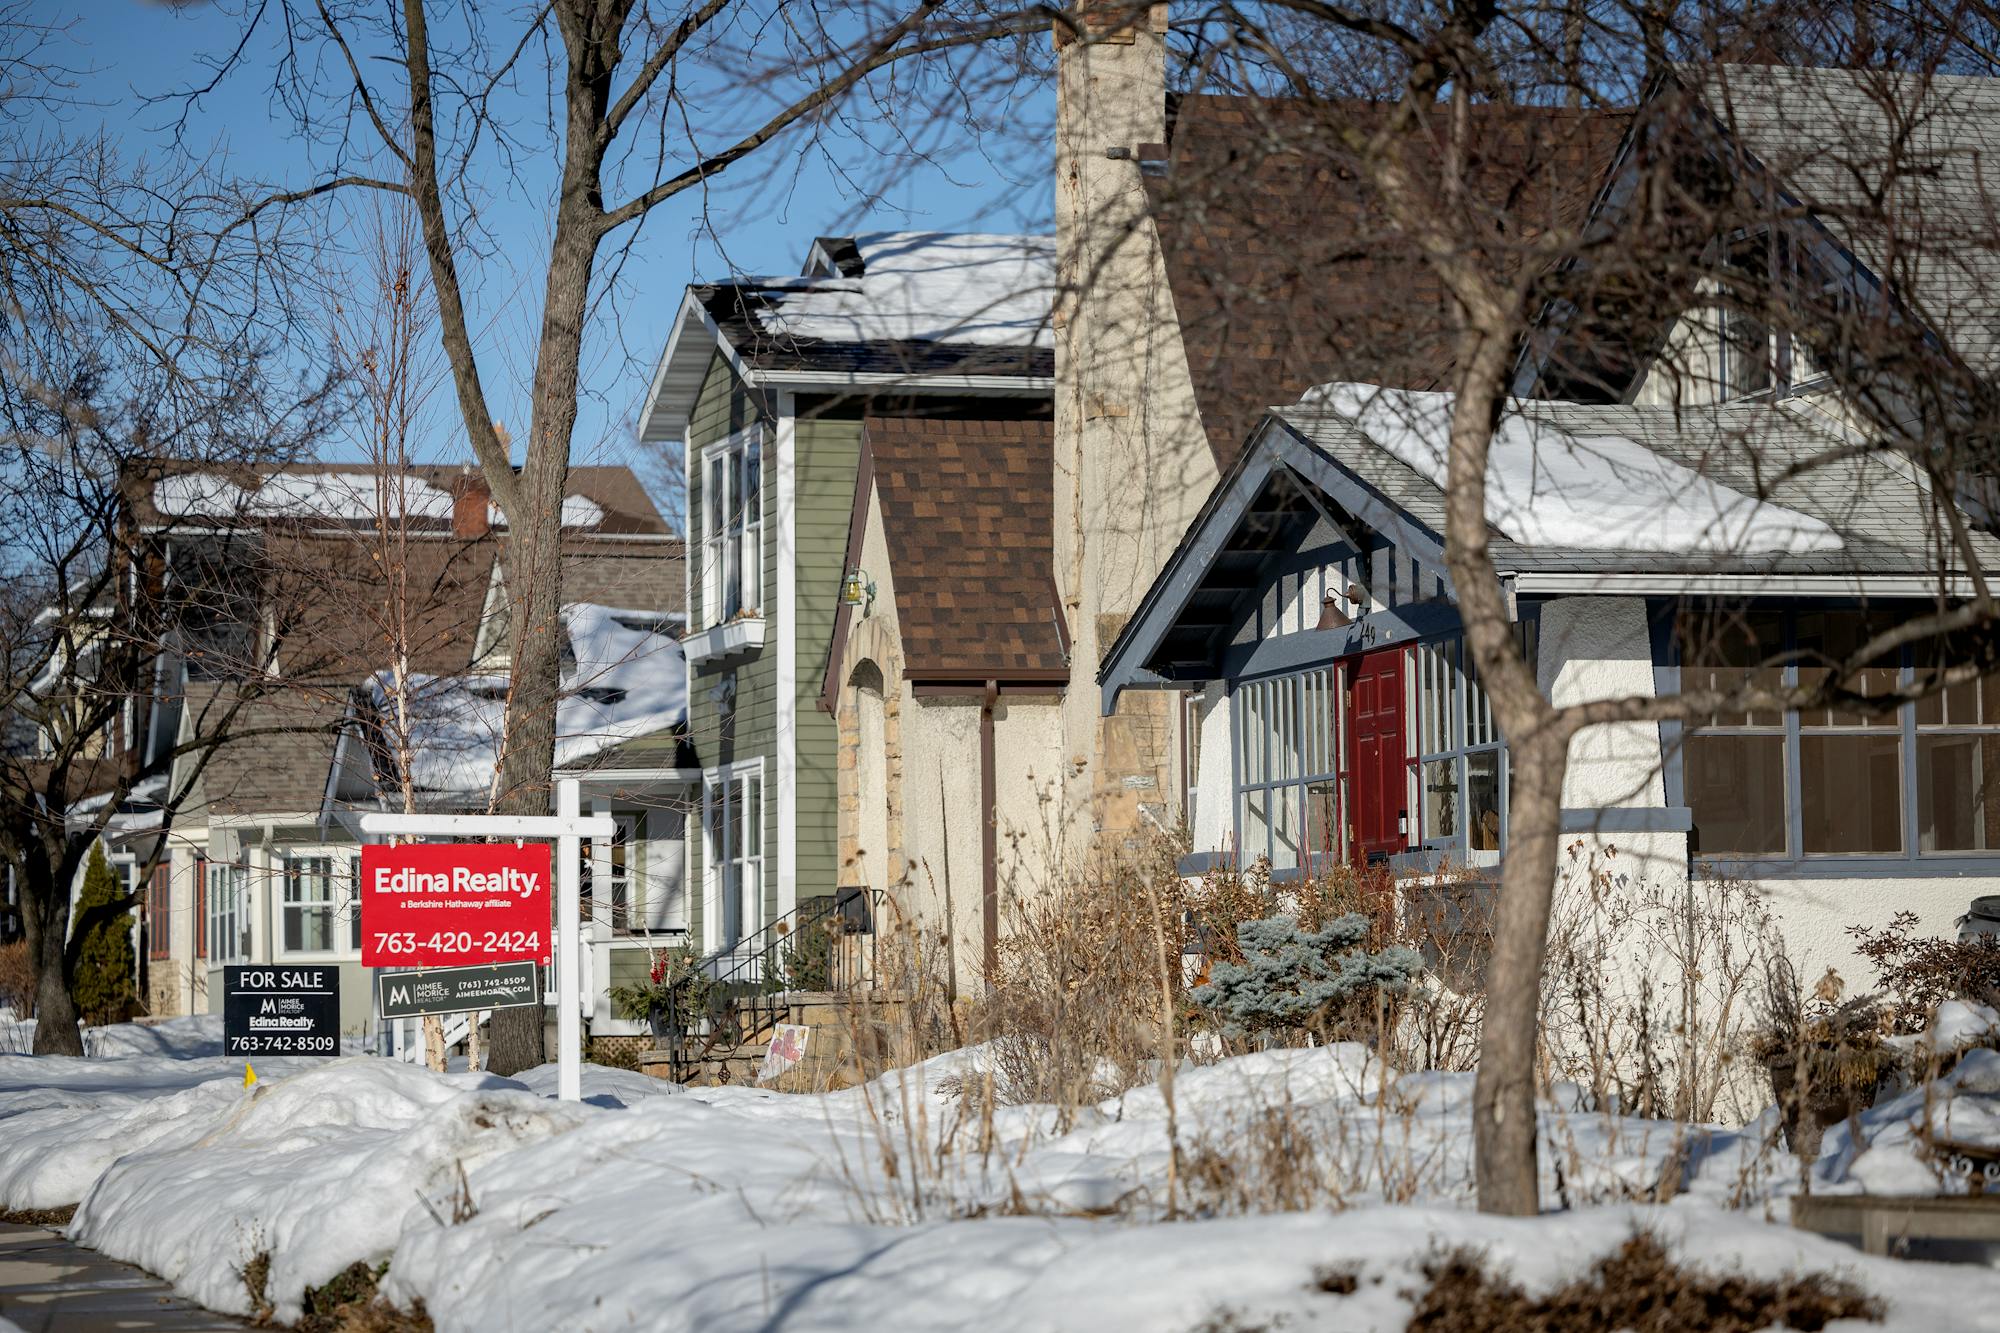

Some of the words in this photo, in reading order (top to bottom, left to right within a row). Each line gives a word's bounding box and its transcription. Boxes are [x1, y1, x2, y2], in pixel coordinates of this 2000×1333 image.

[375, 867, 449, 893] Edina
[408, 900, 443, 908] Berkshire
[445, 900, 483, 909] Hathaway
[485, 900, 512, 908] affiliate
[374, 931, 541, 953] 763-420-2424
[240, 971, 276, 988] FOR
[281, 971, 323, 988] SALE
[458, 980, 481, 990] (763)
[484, 977, 526, 987] 742-8509
[416, 982, 443, 991] AIMEE
[417, 988, 450, 998] MORICE
[249, 1016, 279, 1027] Edina
[231, 1037, 334, 1050] 763-742-8509
